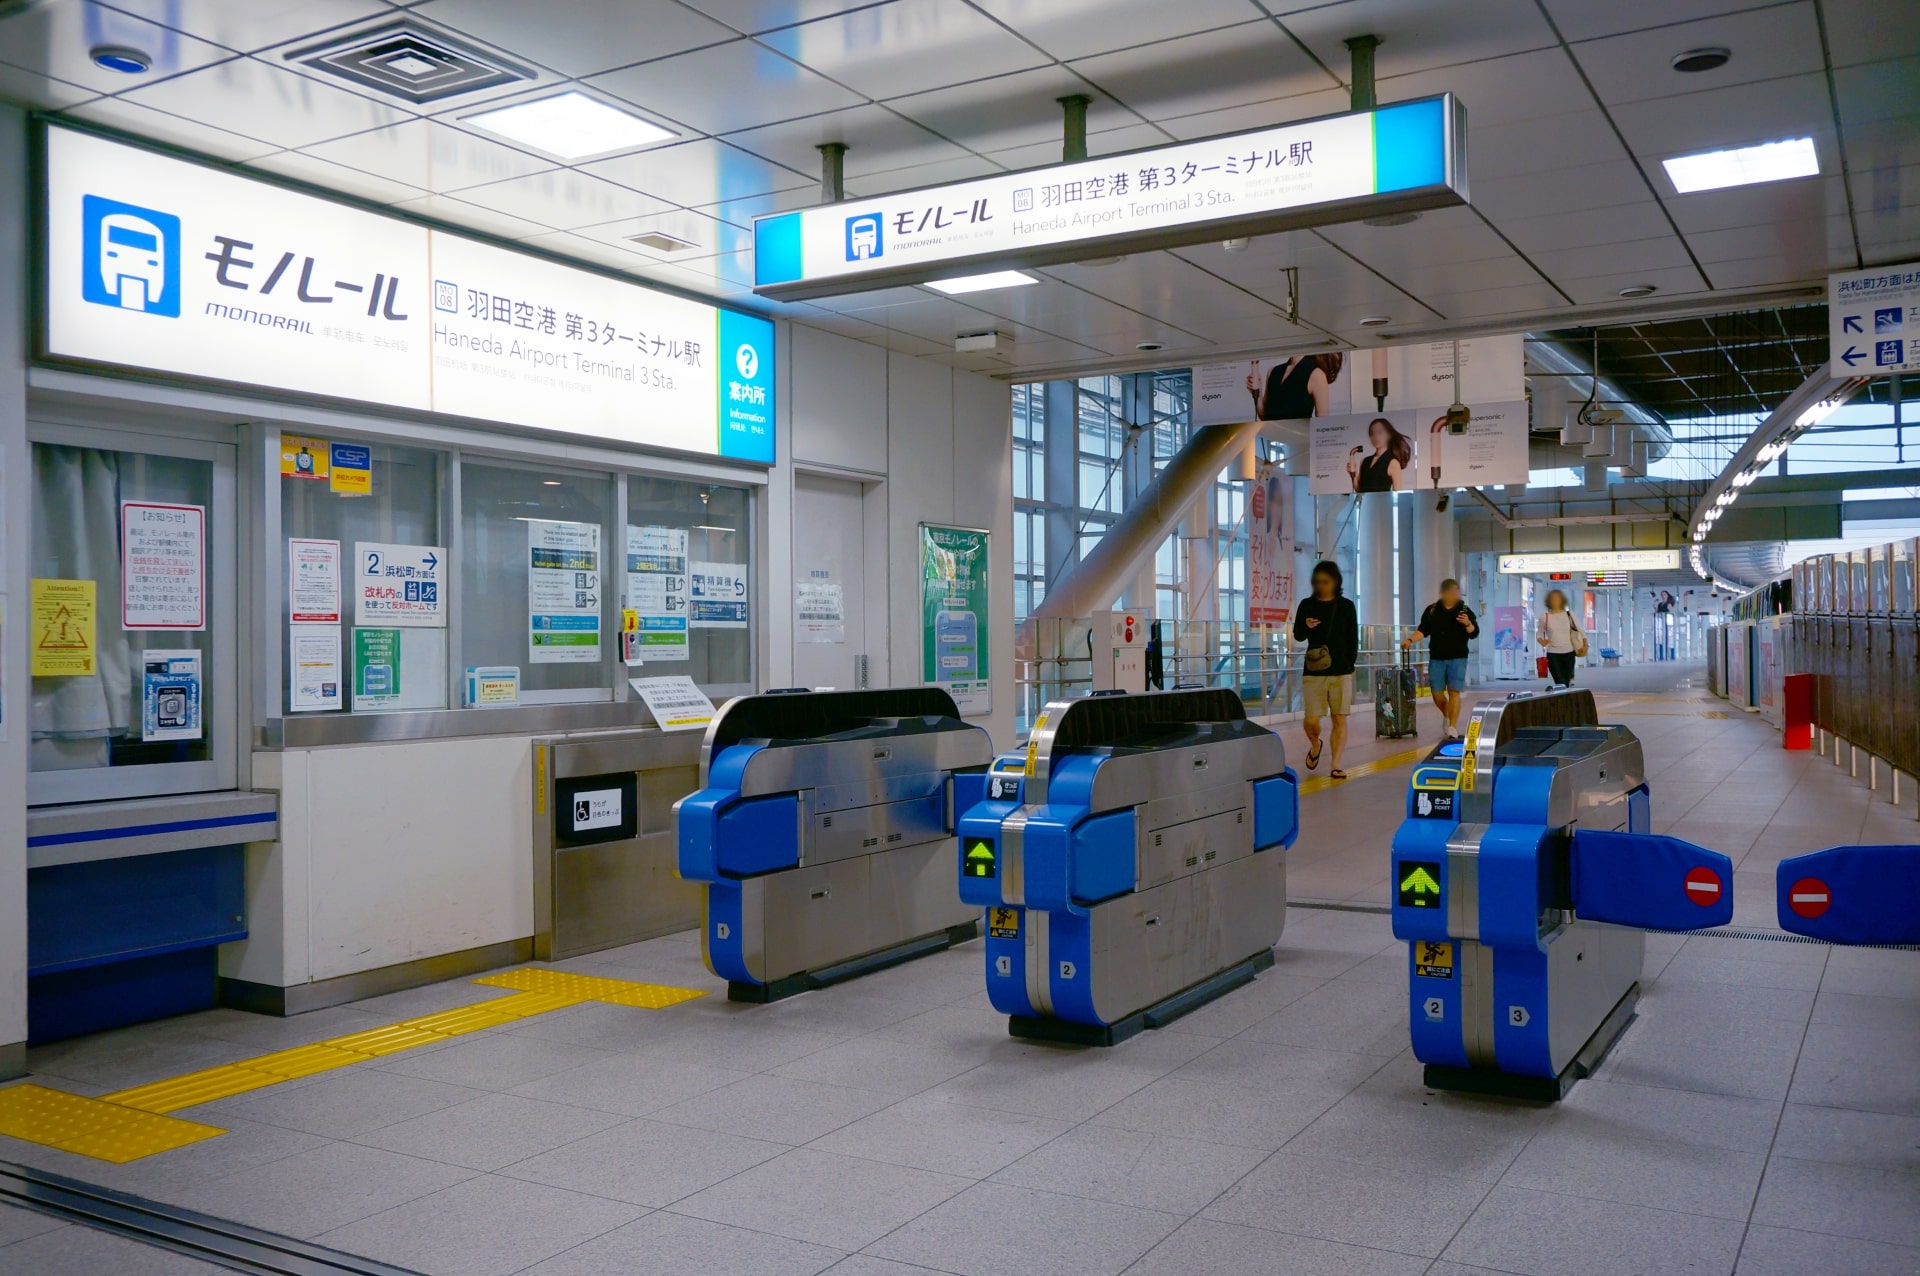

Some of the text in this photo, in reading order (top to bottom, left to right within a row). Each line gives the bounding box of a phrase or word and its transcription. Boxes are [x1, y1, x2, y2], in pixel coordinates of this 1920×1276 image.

[1041, 171, 1129, 208] 羽田空港
[1139, 141, 1313, 192] 第3ターミナル駅
[1017, 199, 1029, 208] 08
[892, 198, 993, 235] モノレール
[1012, 215, 1067, 236] Haneda
[1071, 207, 1123, 228] Airport
[1128, 198, 1190, 218] Terminal
[1194, 193, 1203, 207] 3
[1207, 190, 1234, 206] Sta.
[203, 234, 409, 322] モノレール
[439, 285, 455, 297] MO
[440, 294, 454, 308] 08
[467, 288, 702, 368] 羽田空港 第3ターミナル駅
[434, 321, 678, 391] Haneda Airport Terminal 3 Sta.
[1432, 373, 1455, 382] dyson
[729, 381, 766, 406] 案内所
[1202, 394, 1222, 402] dyson
[729, 407, 766, 424] Information
[335, 449, 368, 462] CSP
[142, 511, 186, 524] 【お知らせ】
[368, 553, 379, 574] 2
[569, 557, 585, 569] 2nd
[385, 565, 436, 579] 浜松町方面は
[364, 586, 403, 600] 改札内の
[364, 600, 438, 611] を使って反対ホームです
[1434, 797, 1451, 805] きっぷ
[1001, 960, 1007, 970] 1
[1063, 964, 1071, 976] 2
[1430, 1002, 1440, 1014] 2
[1513, 1010, 1523, 1022] 3
